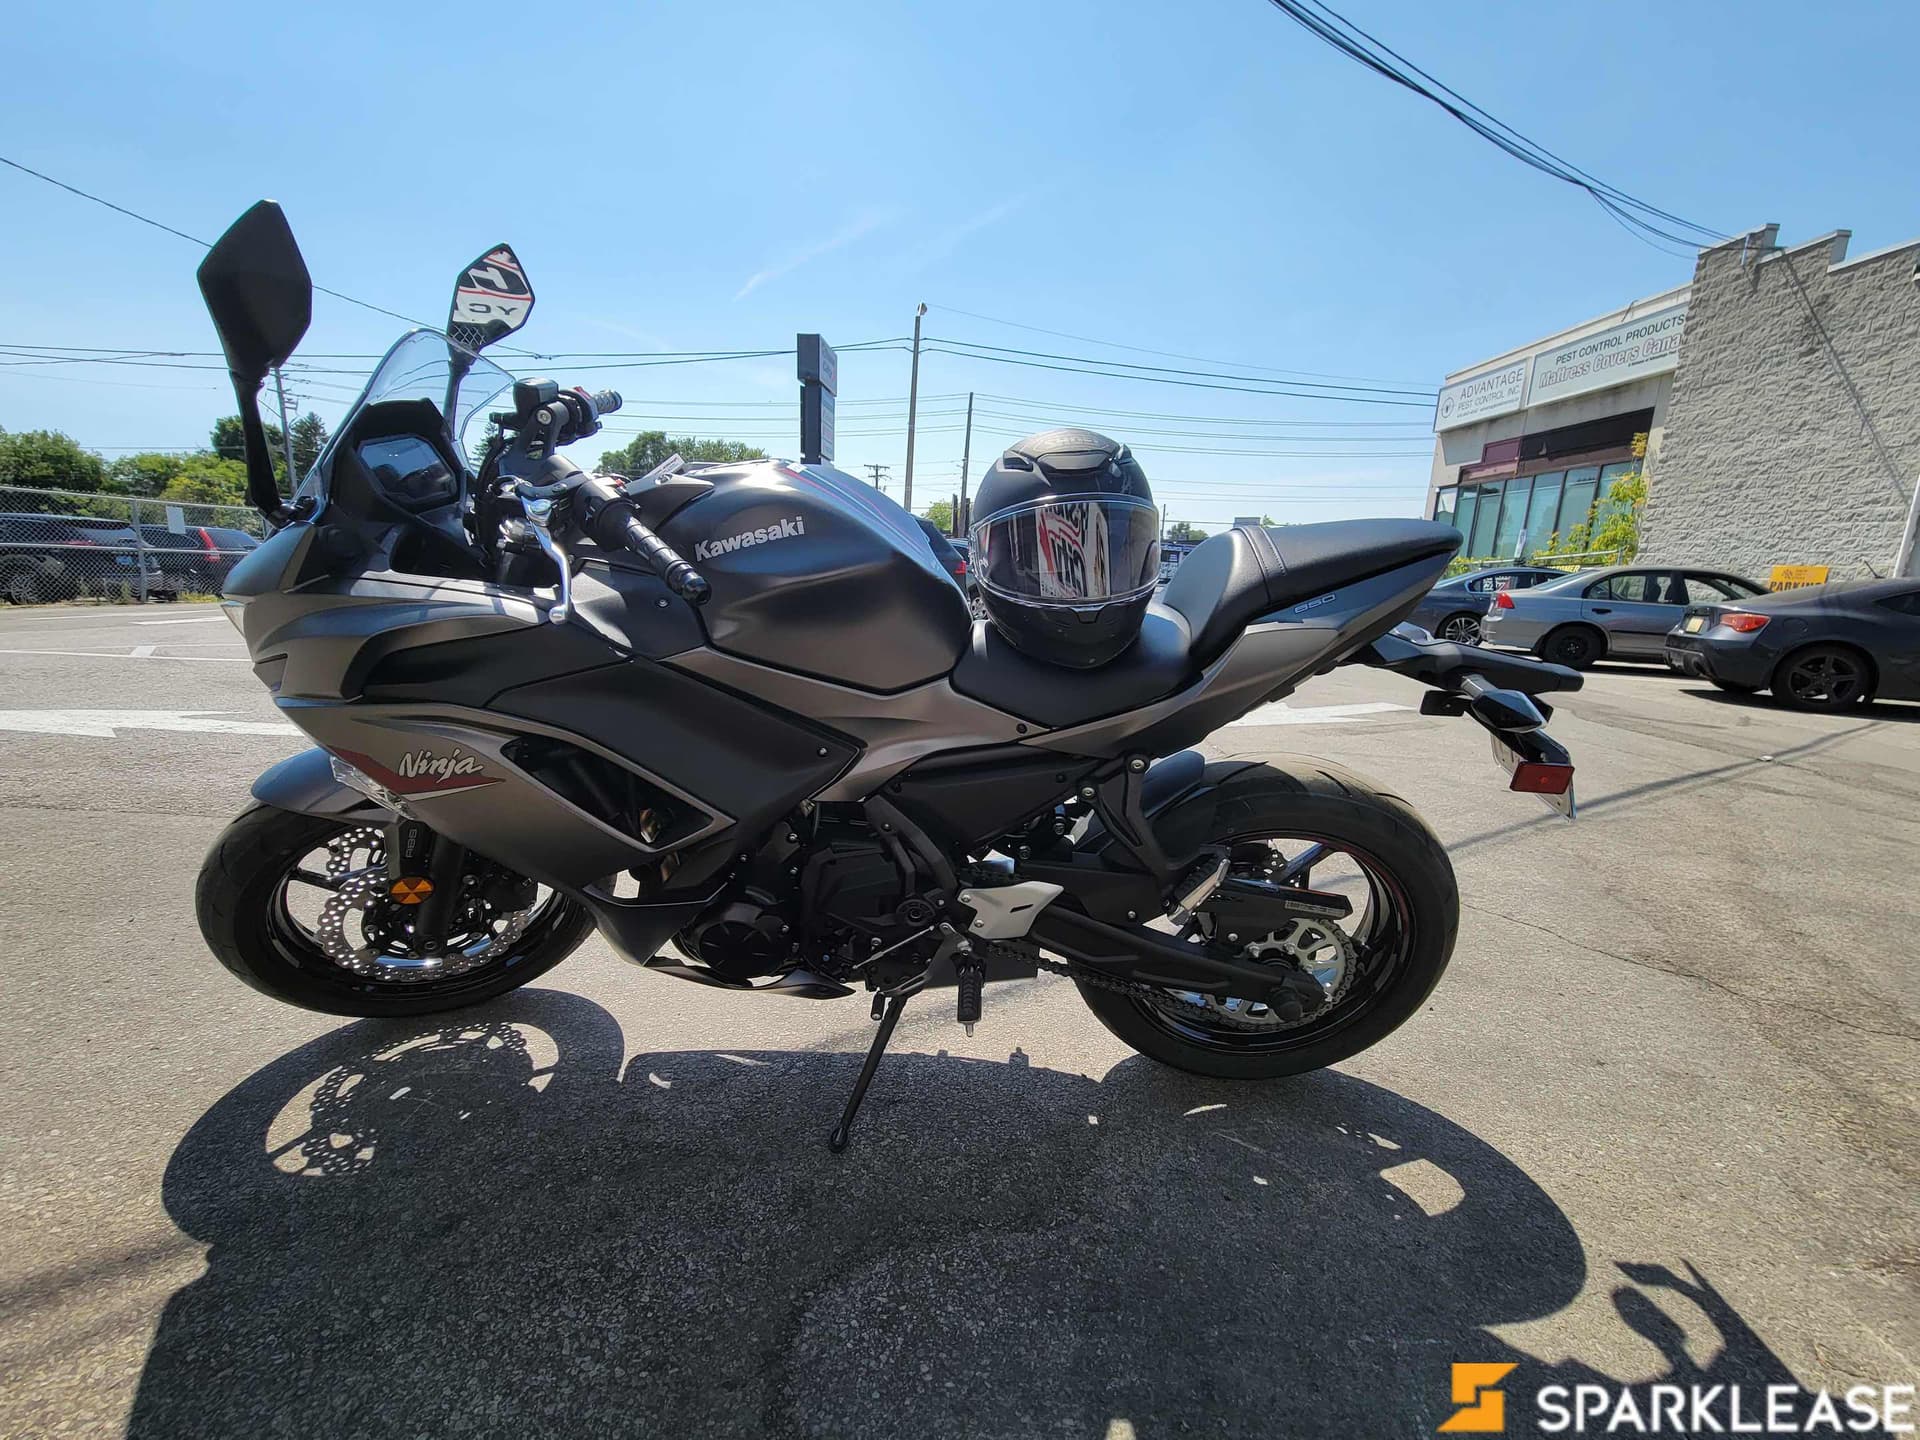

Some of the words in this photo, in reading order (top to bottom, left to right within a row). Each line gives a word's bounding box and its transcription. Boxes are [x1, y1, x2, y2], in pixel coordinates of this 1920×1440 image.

[1555, 352, 1577, 365] PEST
[1578, 335, 1622, 358] CONTROL
[1625, 313, 1685, 343] PRODUCTS
[1459, 367, 1524, 401] ADVANTAGE
[1538, 360, 1591, 389] Mattress
[1592, 345, 1640, 372] Covers
[1457, 399, 1473, 411] PEST
[1474, 391, 1504, 406] CONTROL
[694, 516, 805, 562] Kawasaki
[398, 748, 484, 784] Ninja
[405, 828, 418, 858] ABS
